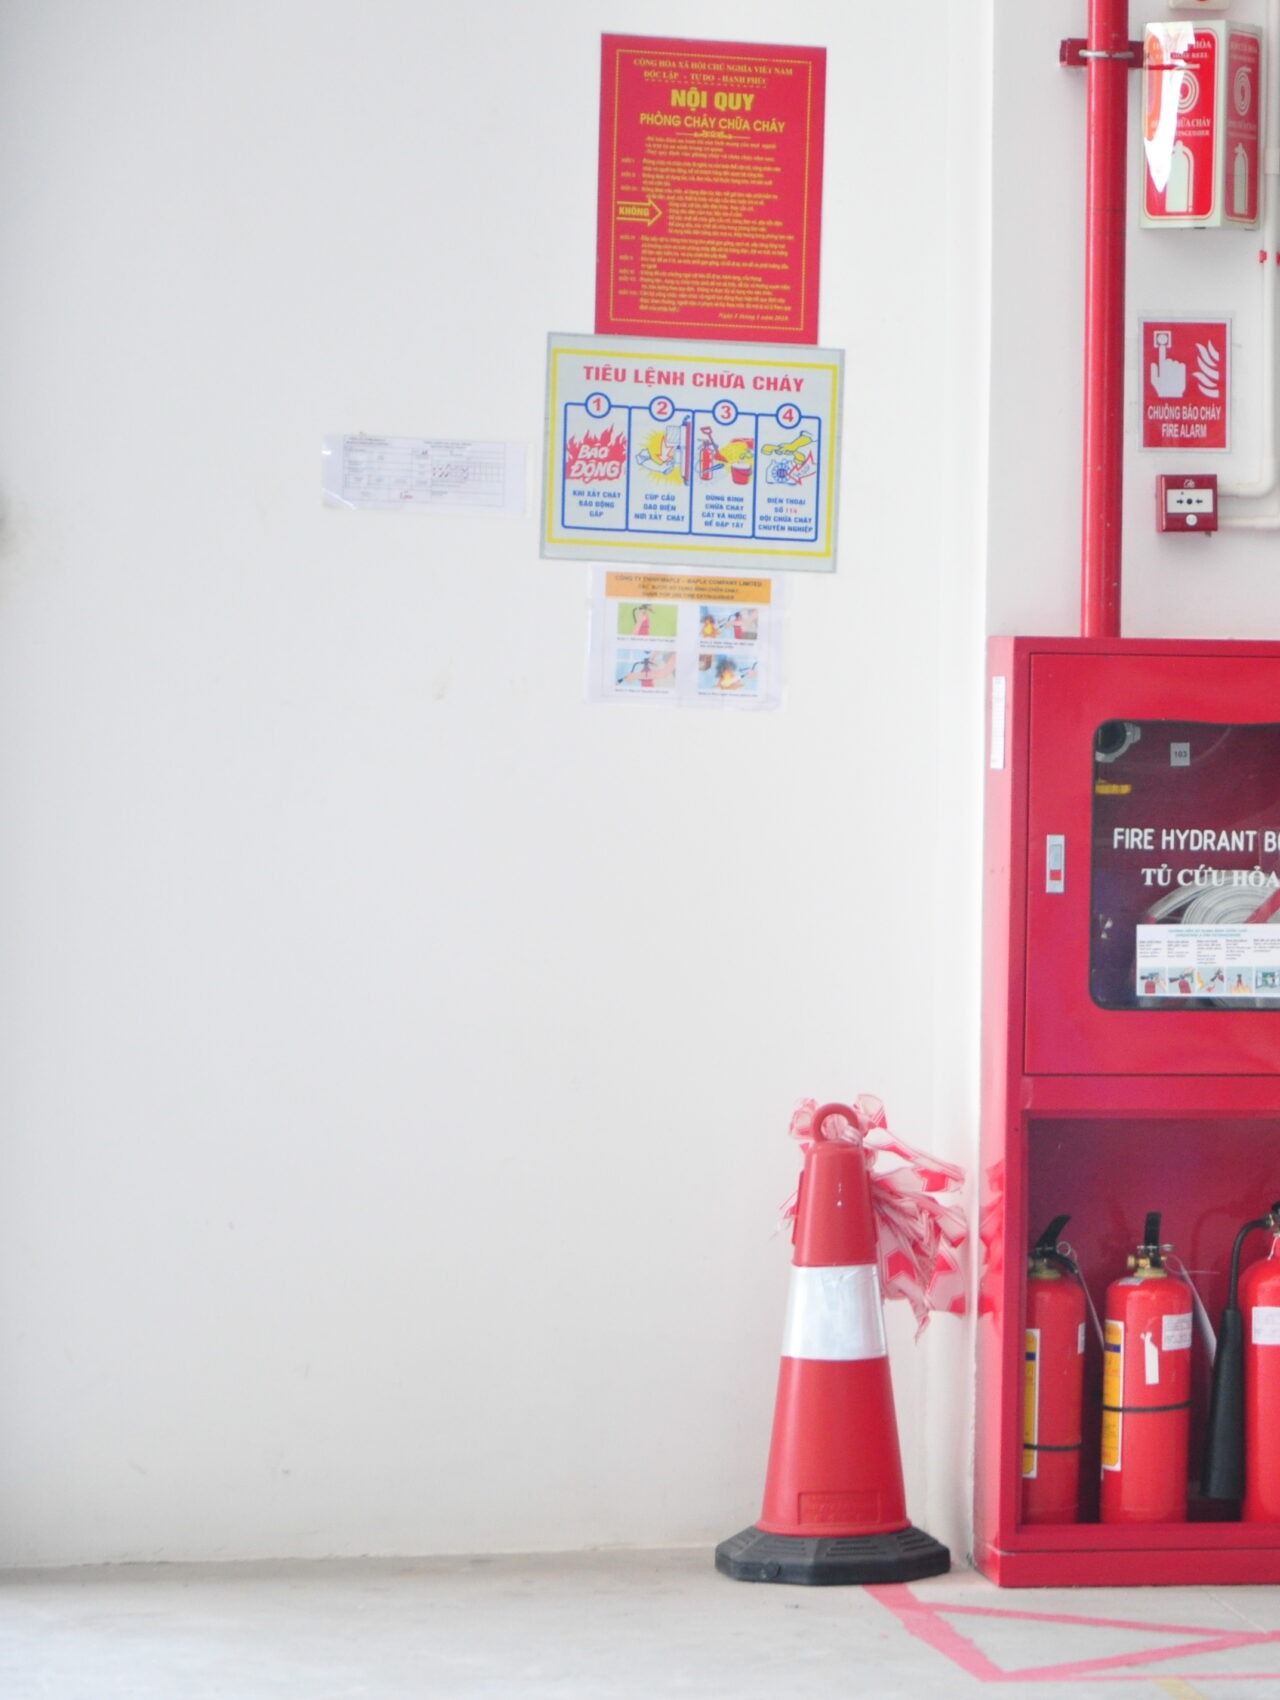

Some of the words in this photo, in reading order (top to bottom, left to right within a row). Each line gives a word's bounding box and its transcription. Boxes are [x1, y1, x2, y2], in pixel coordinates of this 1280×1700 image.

[774, 67, 793, 76] NAM
[671, 87, 708, 112] NỘI
[714, 92, 755, 112] QUY
[639, 111, 681, 127] PHÒNG
[683, 114, 717, 129] CHÁY
[718, 116, 751, 131] CHỮA
[753, 118, 786, 133] CHÁY
[619, 206, 649, 217] KHÔNG
[583, 364, 628, 384] TIÊU
[633, 366, 686, 388] LỆNH
[691, 370, 746, 390] CHỮA
[752, 373, 805, 393] CHÁY
[592, 397, 602, 412] 1
[656, 401, 669, 416] 2
[719, 405, 732, 420] 3
[781, 408, 795, 423] 4
[1148, 404, 1181, 421] CHUÔNG
[1182, 404, 1199, 421] BÁO
[1200, 404, 1222, 421] CHÁY
[1161, 423, 1179, 438] FIRE
[1180, 424, 1208, 438] ALARM
[1113, 828, 1155, 850] FIRE
[1161, 829, 1257, 852] HYDRANT
[1141, 863, 1172, 886] TỦ
[1177, 864, 1227, 887] CỨU
